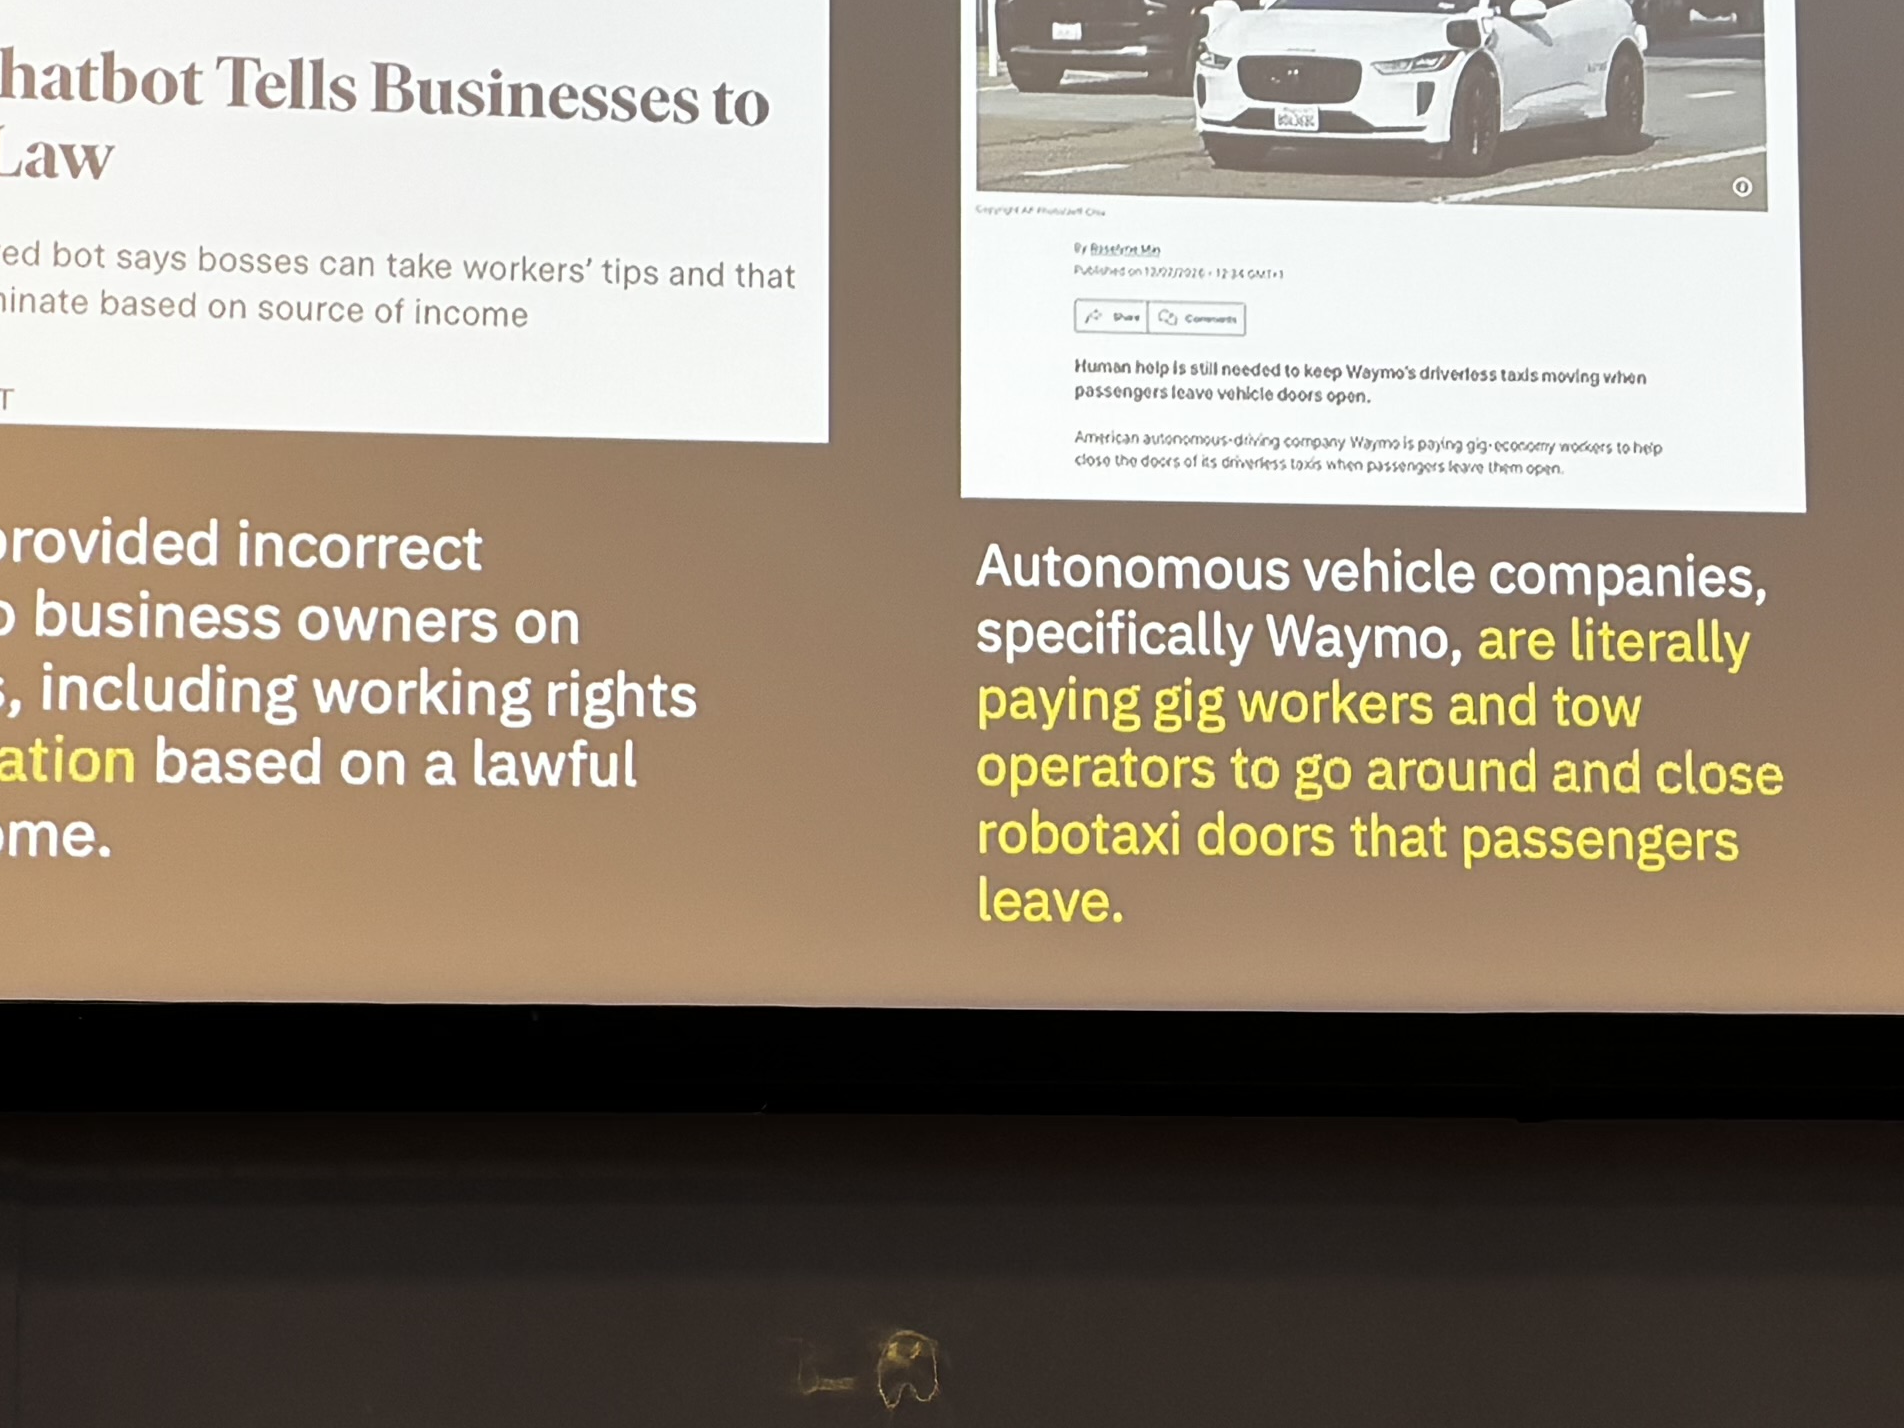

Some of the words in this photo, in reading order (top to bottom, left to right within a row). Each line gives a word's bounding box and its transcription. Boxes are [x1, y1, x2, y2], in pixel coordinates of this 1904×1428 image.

[216, 56, 357, 112] Tells
[371, 62, 699, 124] Businesses
[713, 82, 769, 127] to
[239, 519, 483, 571] incorrect
[976, 543, 1290, 591] Autonomous
[1303, 547, 1475, 593] vehicle
[1490, 553, 1766, 606] companies,
